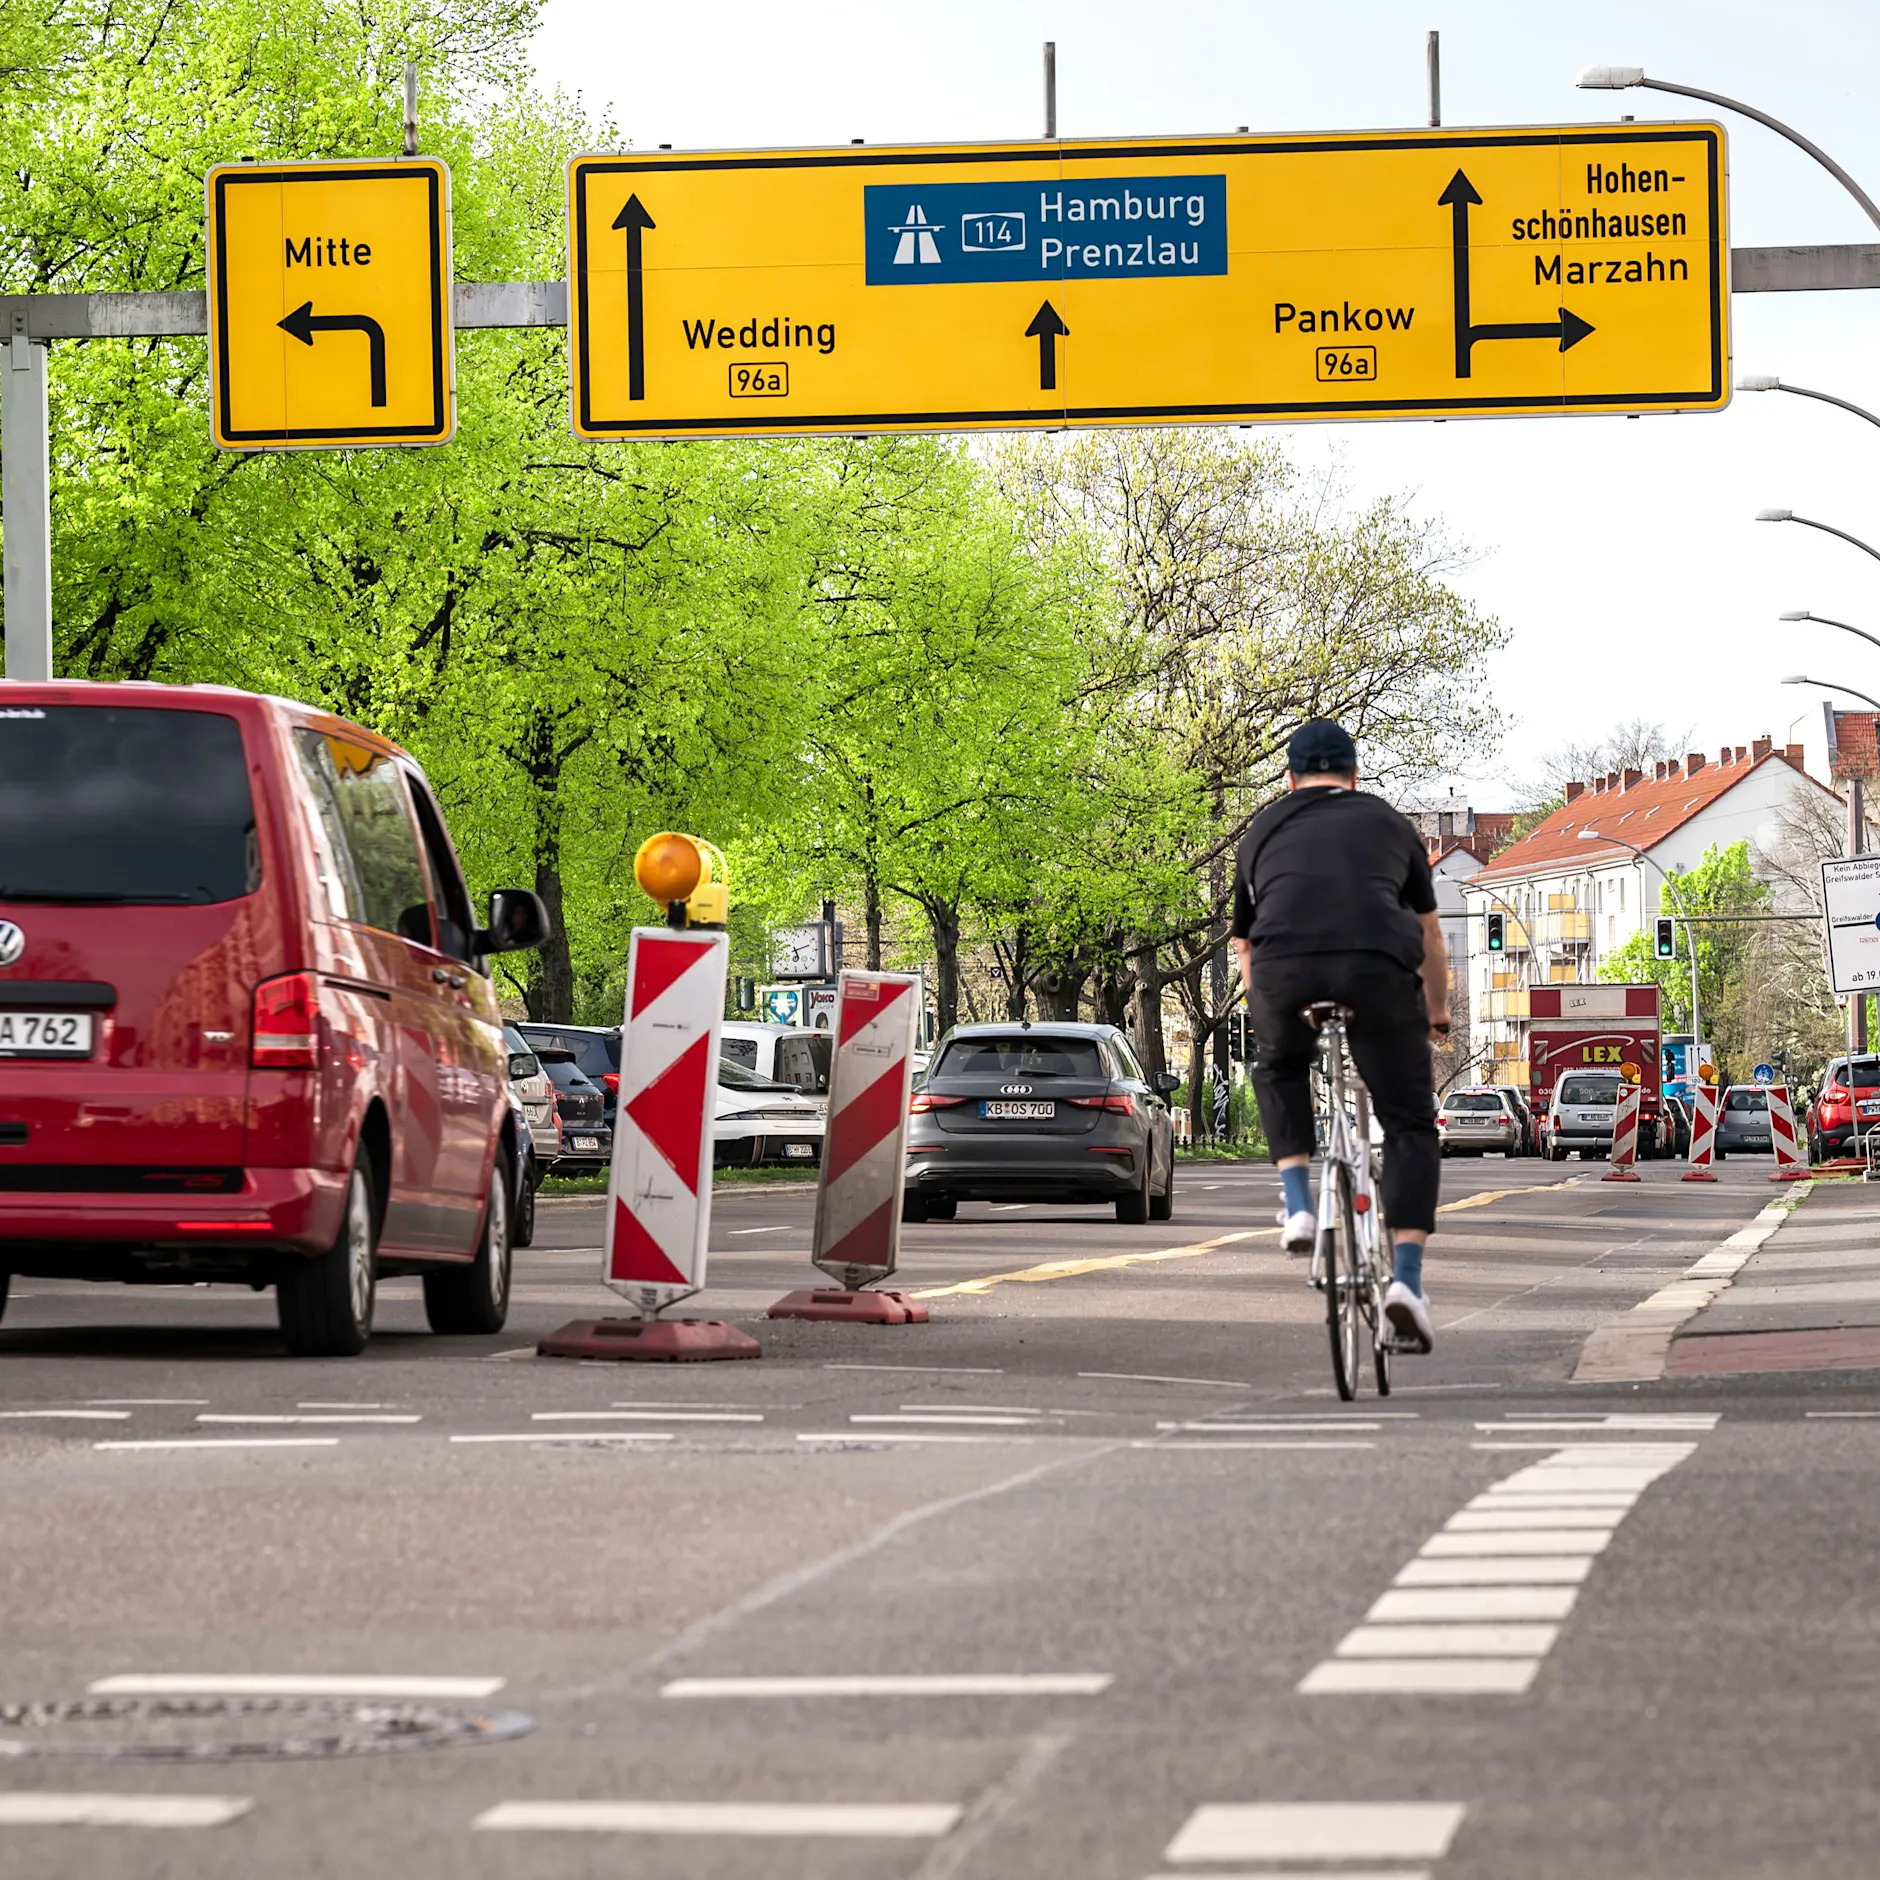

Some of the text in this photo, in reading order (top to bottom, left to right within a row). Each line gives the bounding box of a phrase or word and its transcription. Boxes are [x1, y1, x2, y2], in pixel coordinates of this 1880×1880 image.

[1587, 163, 1686, 194] Hohen-
[1040, 190, 1205, 226] Hamburg
[975, 221, 1012, 243] 114
[1512, 208, 1687, 241] schönhausen
[285, 237, 372, 268] Mitte
[1041, 235, 1200, 268] Prenzlau
[1535, 252, 1689, 286] Marzahn
[1275, 302, 1415, 333] Pankow
[682, 317, 836, 354] Wedding
[1324, 353, 1369, 376] 96a
[736, 368, 782, 393] 96a
[1825, 872, 1873, 884] Greifswalder
[1833, 861, 1880, 873] Kein Abbieg
[1831, 914, 1873, 923] Greifswalder
[1852, 972, 1864, 981] ab
[1569, 998, 1587, 1008] LEX
[24, 1017, 78, 1045] 762
[1582, 1046, 1623, 1063] LEX
[986, 1103, 1053, 1115] KB OS 700
